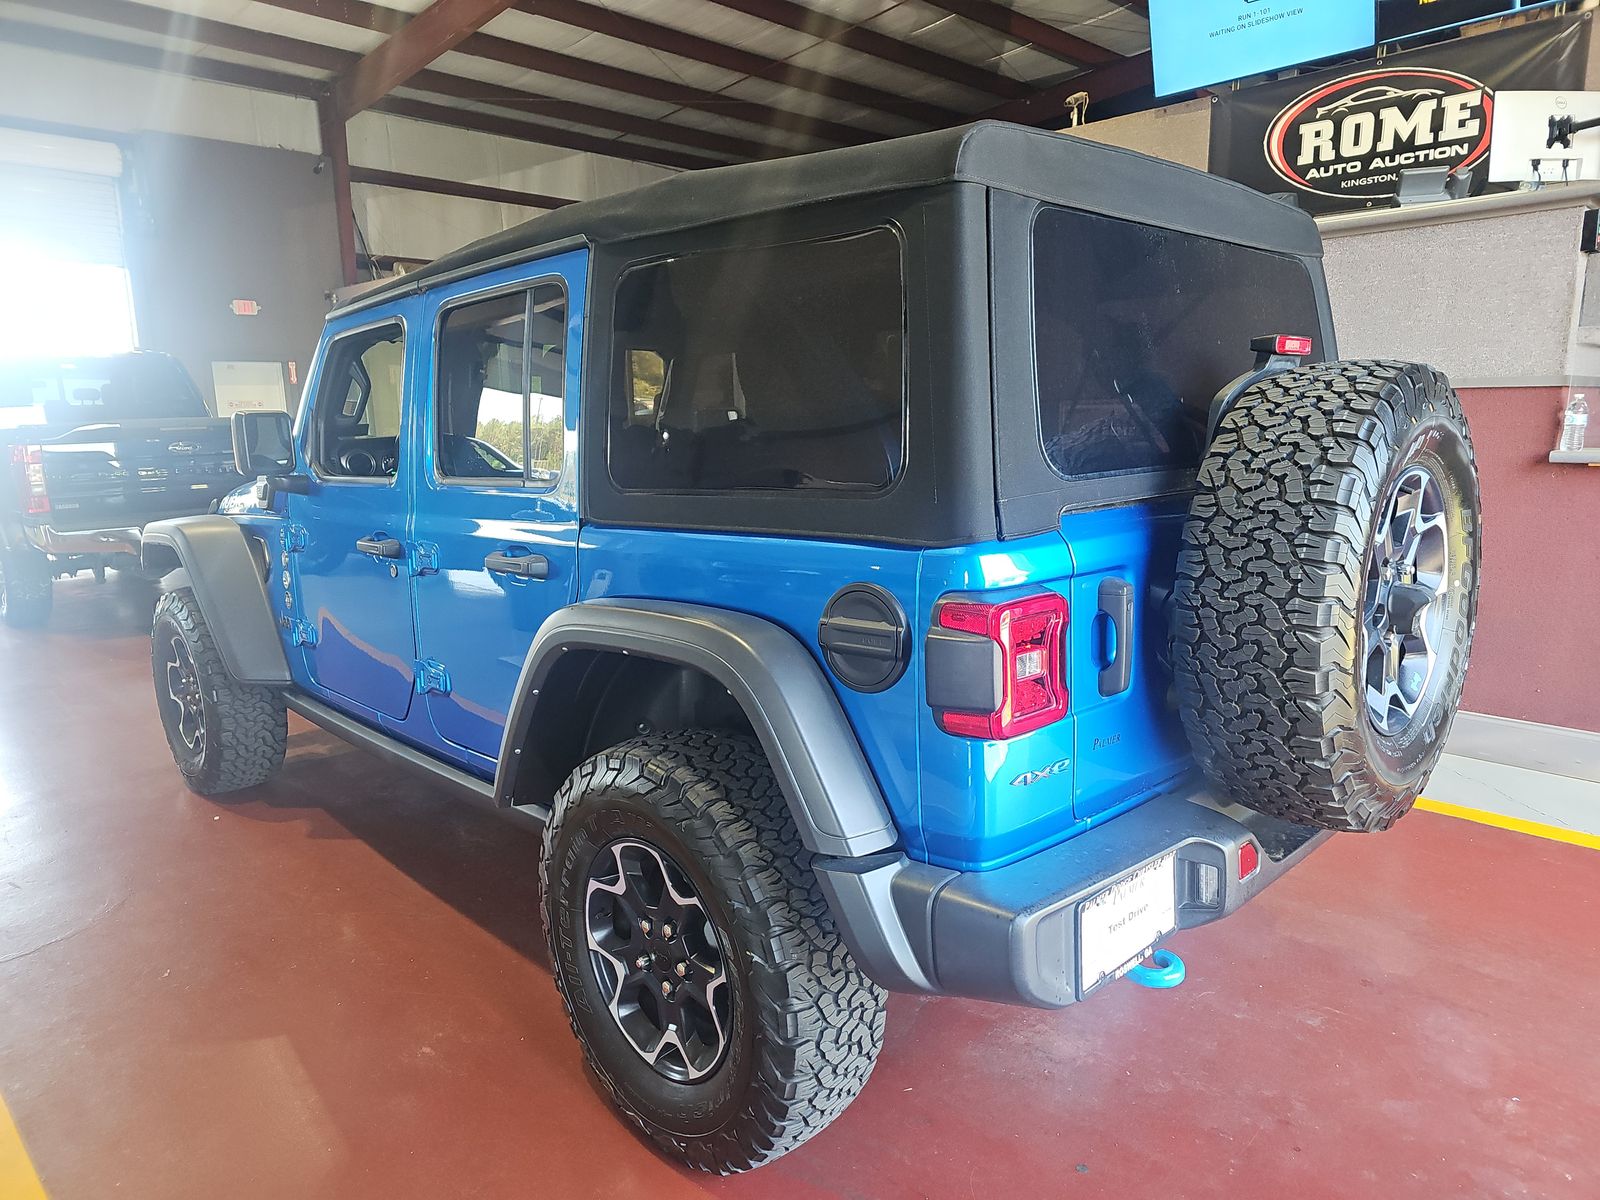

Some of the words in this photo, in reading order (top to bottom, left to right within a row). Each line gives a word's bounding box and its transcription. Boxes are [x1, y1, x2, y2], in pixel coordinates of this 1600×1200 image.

[1209, 26, 1236, 38] WAITING
[1236, 23, 1247, 31] ON
[1247, 12, 1285, 28] SLIDESHOW
[1286, 7, 1304, 17] VIEW
[1238, 14, 1252, 22] RUN
[1297, 89, 1482, 166] ROME
[1305, 161, 1362, 180] AUTO
[1369, 143, 1469, 171] AUCTION
[1341, 173, 1399, 189] KINGSTON,
[1108, 915, 1126, 935] Test
[1128, 903, 1149, 922] Drive
